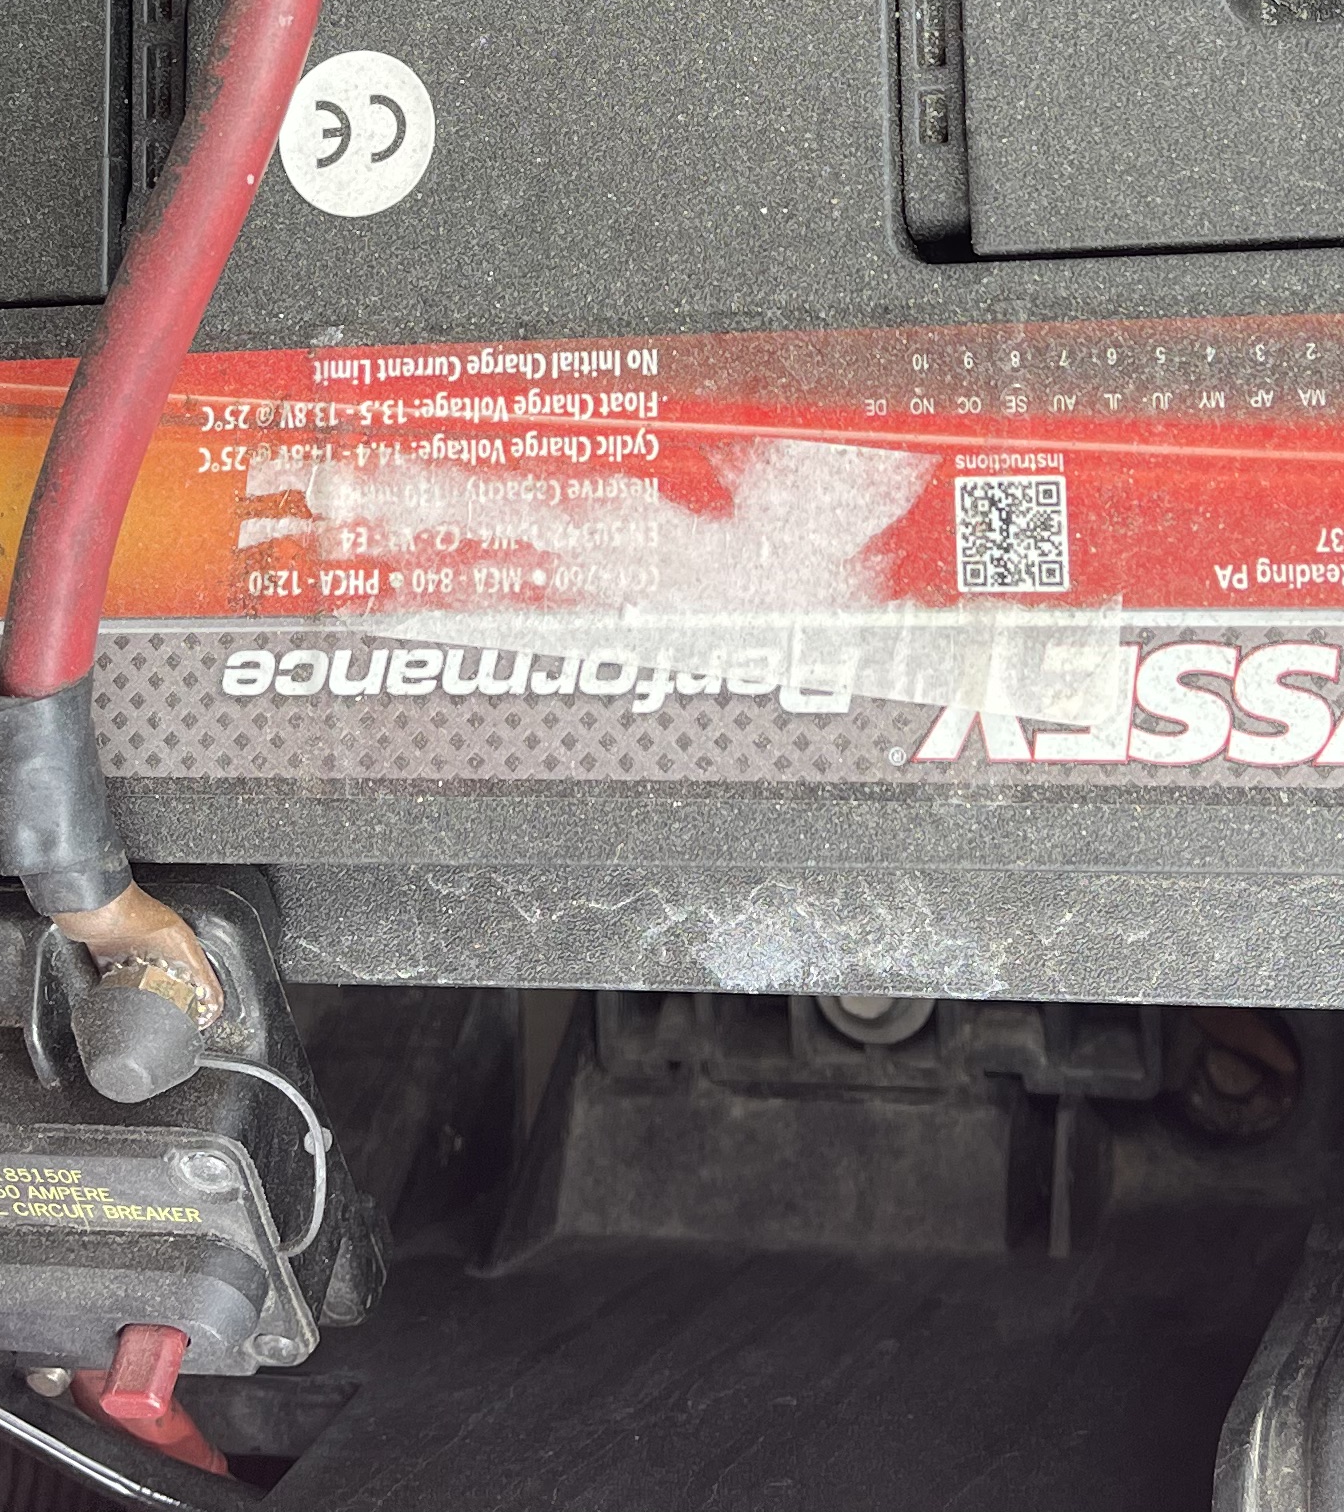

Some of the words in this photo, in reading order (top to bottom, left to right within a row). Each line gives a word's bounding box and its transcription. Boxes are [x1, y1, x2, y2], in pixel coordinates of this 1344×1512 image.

[466, 346, 547, 381] Charge
[551, 348, 621, 380] Initial
[626, 347, 659, 376] No
[911, 352, 930, 371] 10
[963, 351, 975, 370] 9
[1010, 349, 1021, 368] 8
[1106, 348, 1118, 366] 6
[1156, 346, 1167, 364] 5
[1255, 343, 1266, 362] 3
[1306, 342, 1316, 361] 2
[312, 358, 372, 387] Limit
[375, 354, 462, 384] Current
[413, 390, 508, 424] Voltage:
[513, 387, 595, 421] Charge
[599, 390, 659, 419] Float
[864, 398, 888, 417] DE
[909, 397, 935, 416] NO
[956, 396, 982, 415] OC
[1005, 394, 1029, 414] SE
[1053, 393, 1077, 412] AU
[1198, 390, 1226, 410] MY
[1250, 388, 1274, 408] AP
[1297, 387, 1326, 407] MA
[200, 403, 251, 432] 25°C
[279, 400, 338, 430] 13.8V
[359, 398, 408, 426] 13.5
[355, 440, 403, 468] 14.4
[409, 432, 505, 467] Voltage:
[510, 430, 592, 464] Charge
[595, 427, 659, 463] Cyclic
[197, 445, 246, 473] 25°C
[955, 452, 1065, 473] Instructions
[566, 477, 659, 504] Reserve
[339, 526, 368, 554] E4
[248, 570, 303, 597] 1250
[319, 568, 380, 596] PHCA
[411, 567, 454, 594] 840
[473, 567, 522, 594] MCA
[1213, 563, 1249, 590] PA
[27, 1185, 115, 1203] AMPERE
[12, 1201, 95, 1219] CIRCUIT
[103, 1204, 203, 1223] BREAKER
